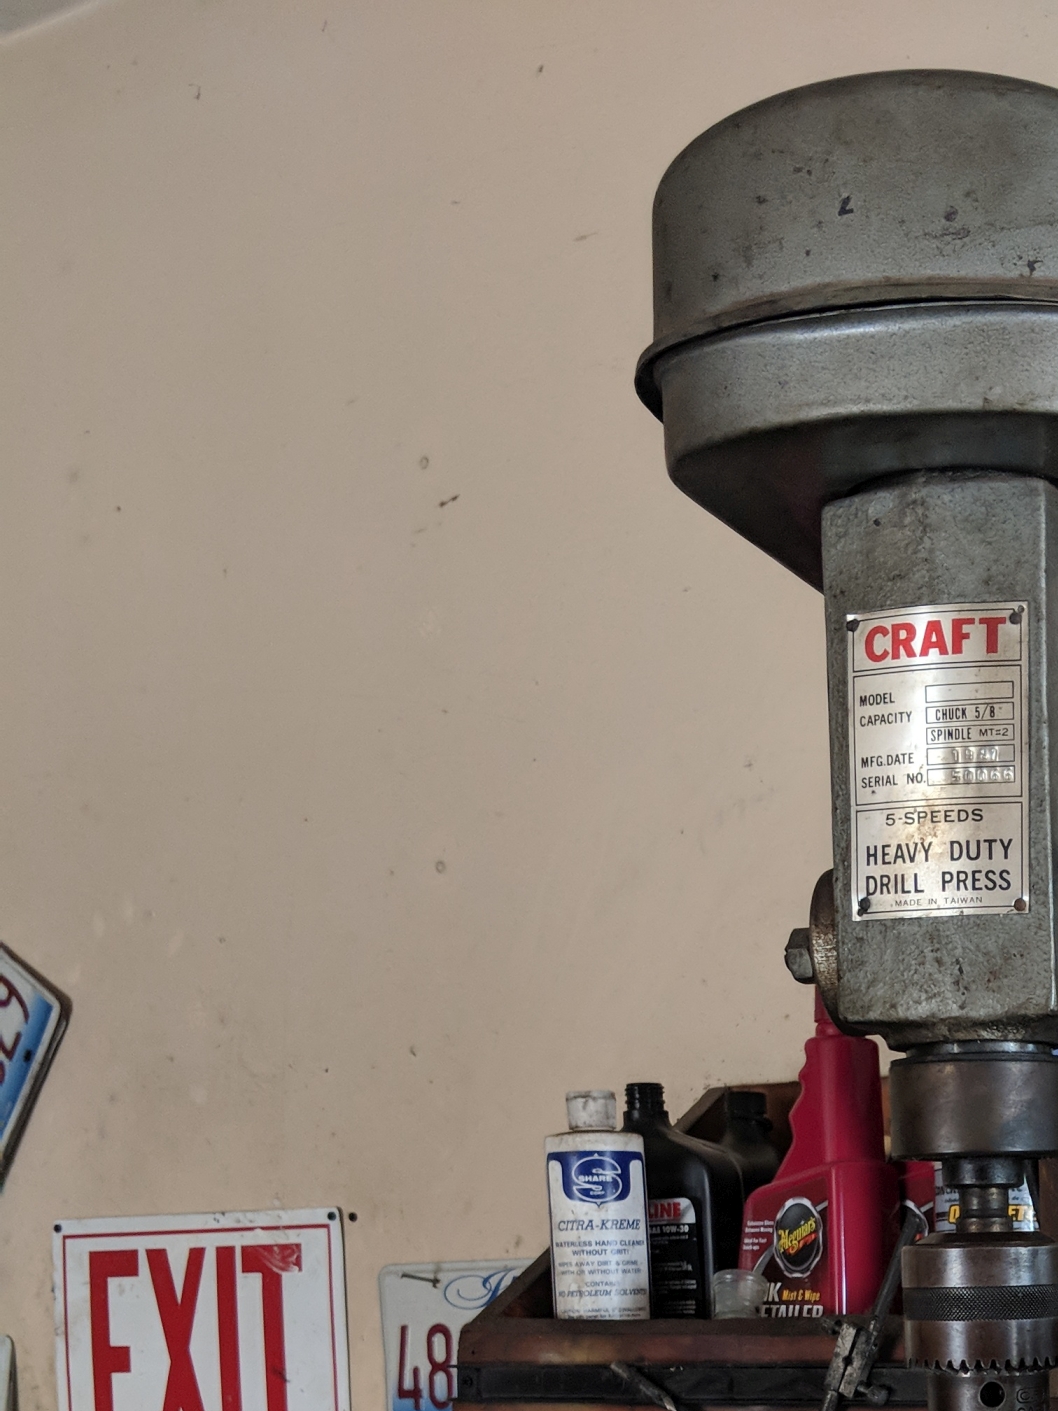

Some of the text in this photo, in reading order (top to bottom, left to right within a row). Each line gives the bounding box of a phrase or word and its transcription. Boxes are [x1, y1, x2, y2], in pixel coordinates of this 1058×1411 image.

[865, 617, 1006, 663] CRAFT
[859, 693, 895, 707] MODEL
[859, 704, 995, 727] CAPACITY CHUCK 5/8
[930, 727, 1009, 741] SPINDLE MT=2
[861, 752, 914, 768] MFG.DATE
[861, 775, 898, 788] SERIAL
[906, 772, 926, 785] NO.
[885, 808, 984, 826] 5-SPEEDS
[866, 838, 1013, 867] HEAVY DUTY
[866, 869, 1011, 897] DRILL PRESS
[894, 896, 983, 907] MADE IN TAIWAN
[578, 1174, 613, 1182] SHARE
[648, 1202, 681, 1219] LINE
[557, 1219, 641, 1231] CITRA-KREME
[662, 1224, 690, 1233] 10W-30
[567, 1289, 613, 1297] PETROLEUM
[782, 1290, 798, 1301] Mist
[805, 1289, 821, 1303] Wipe
